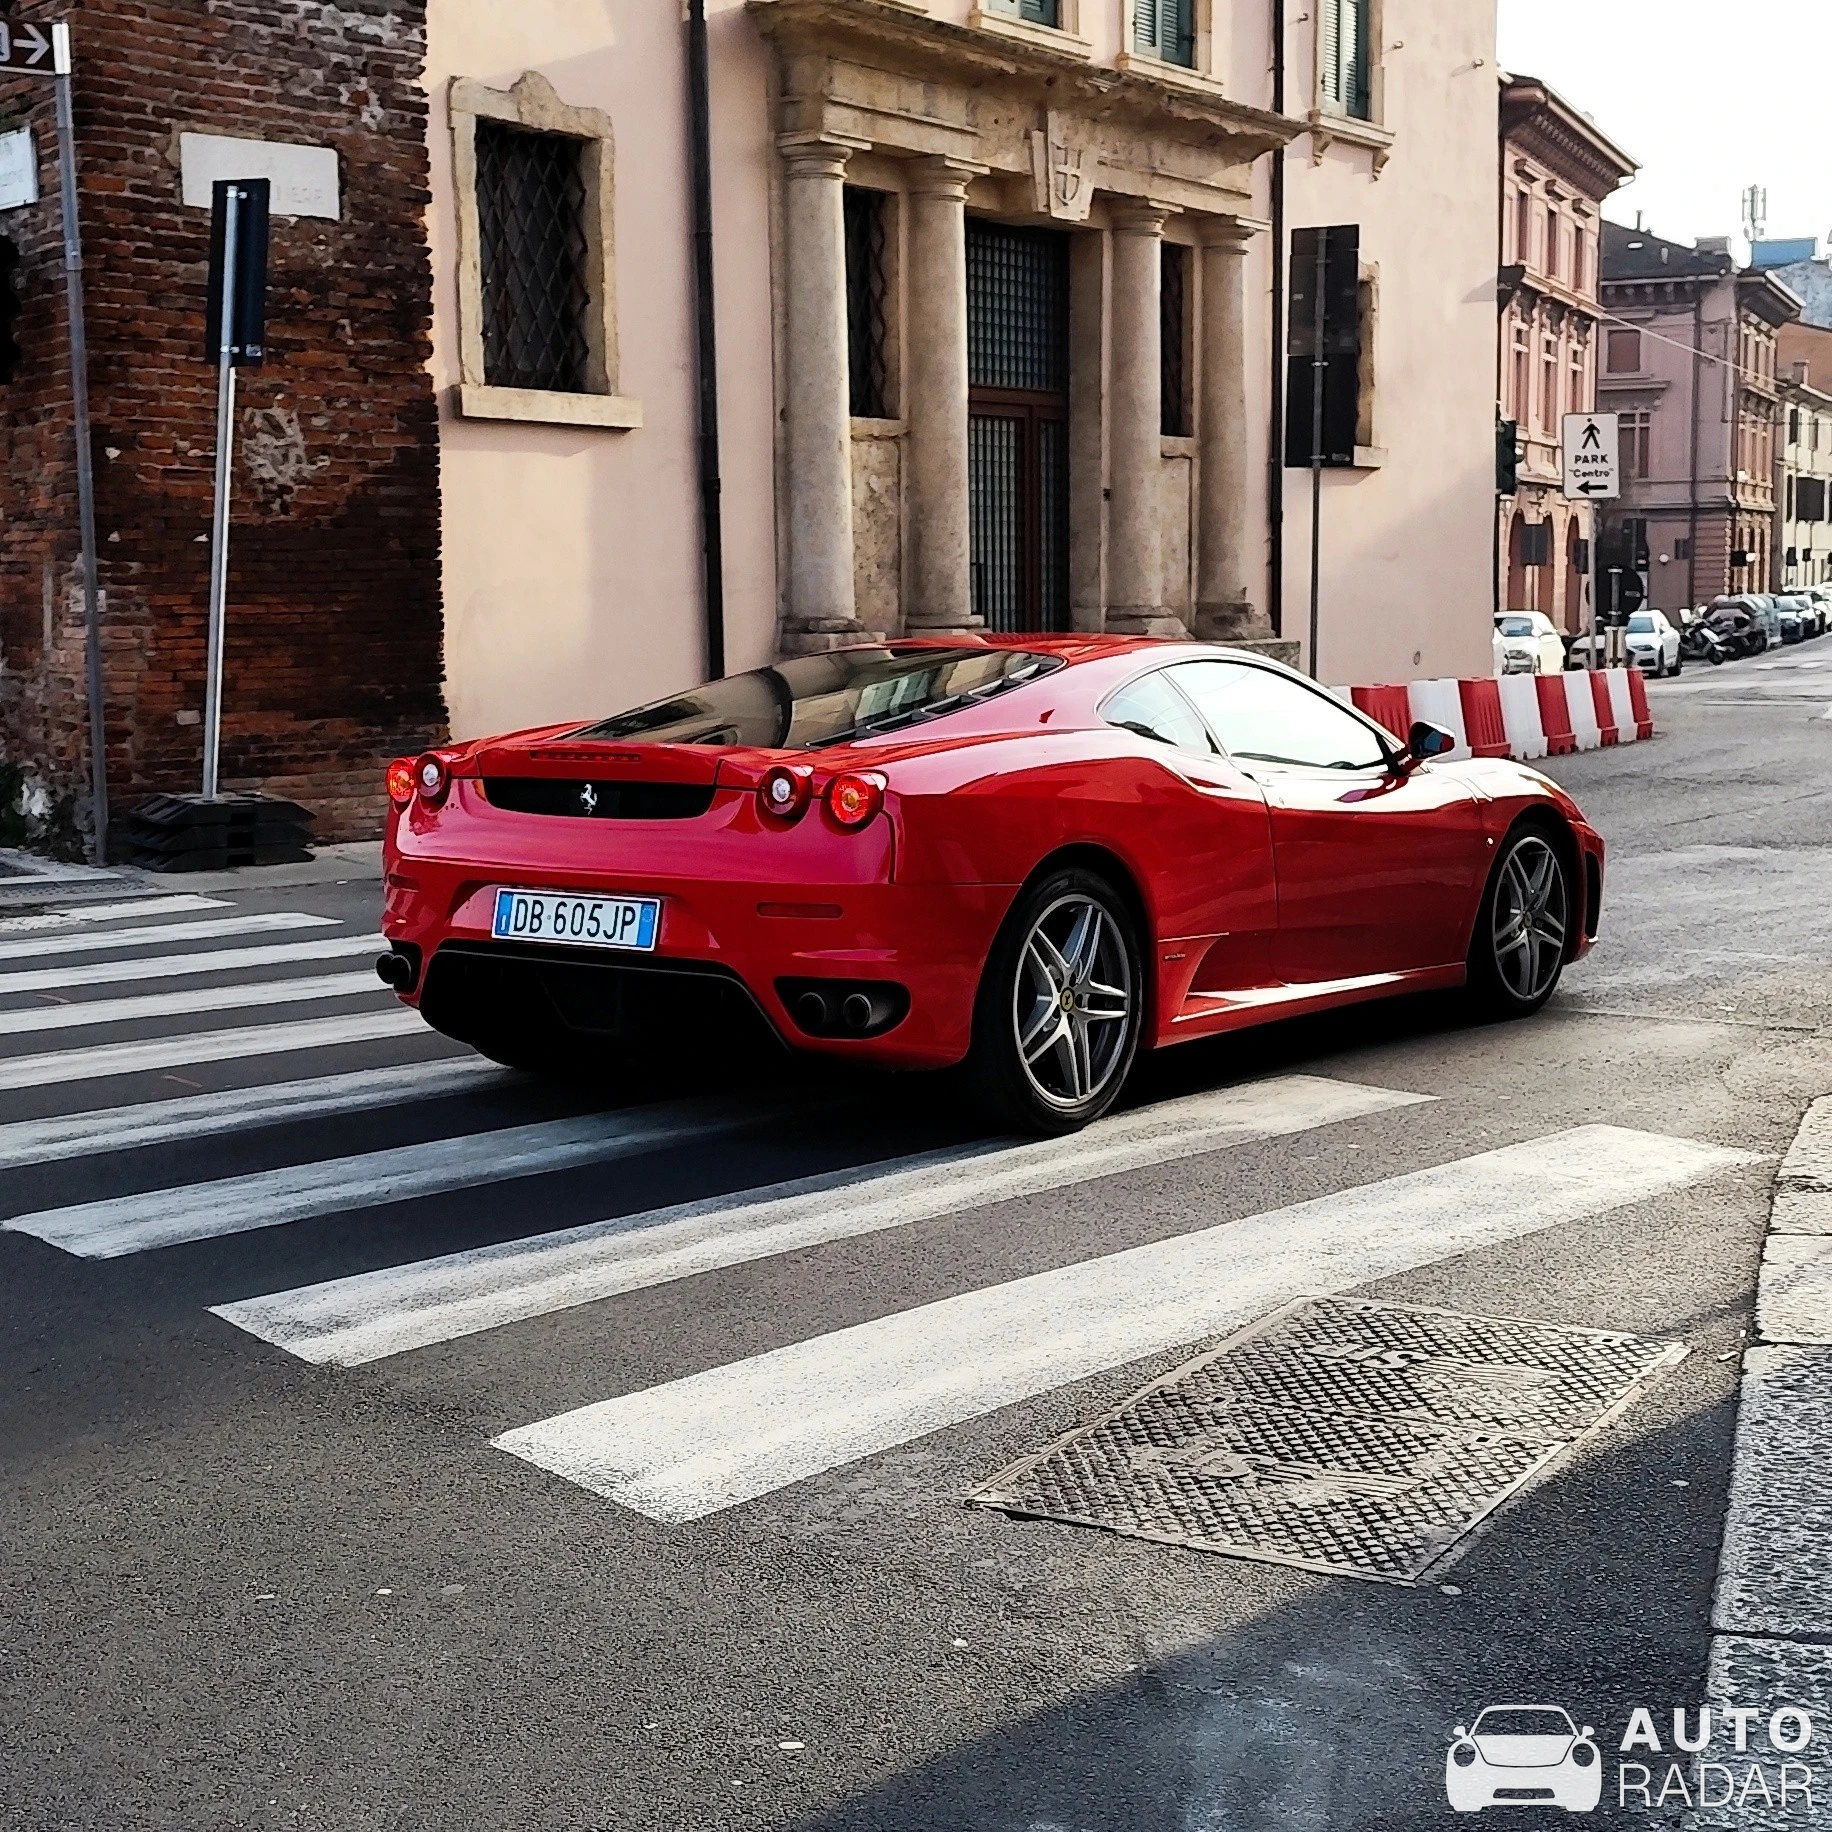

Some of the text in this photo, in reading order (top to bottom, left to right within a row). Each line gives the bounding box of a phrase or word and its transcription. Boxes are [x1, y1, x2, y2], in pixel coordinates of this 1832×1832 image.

[1574, 454, 1608, 464] PARK
[513, 899, 636, 941] DB 605JP
